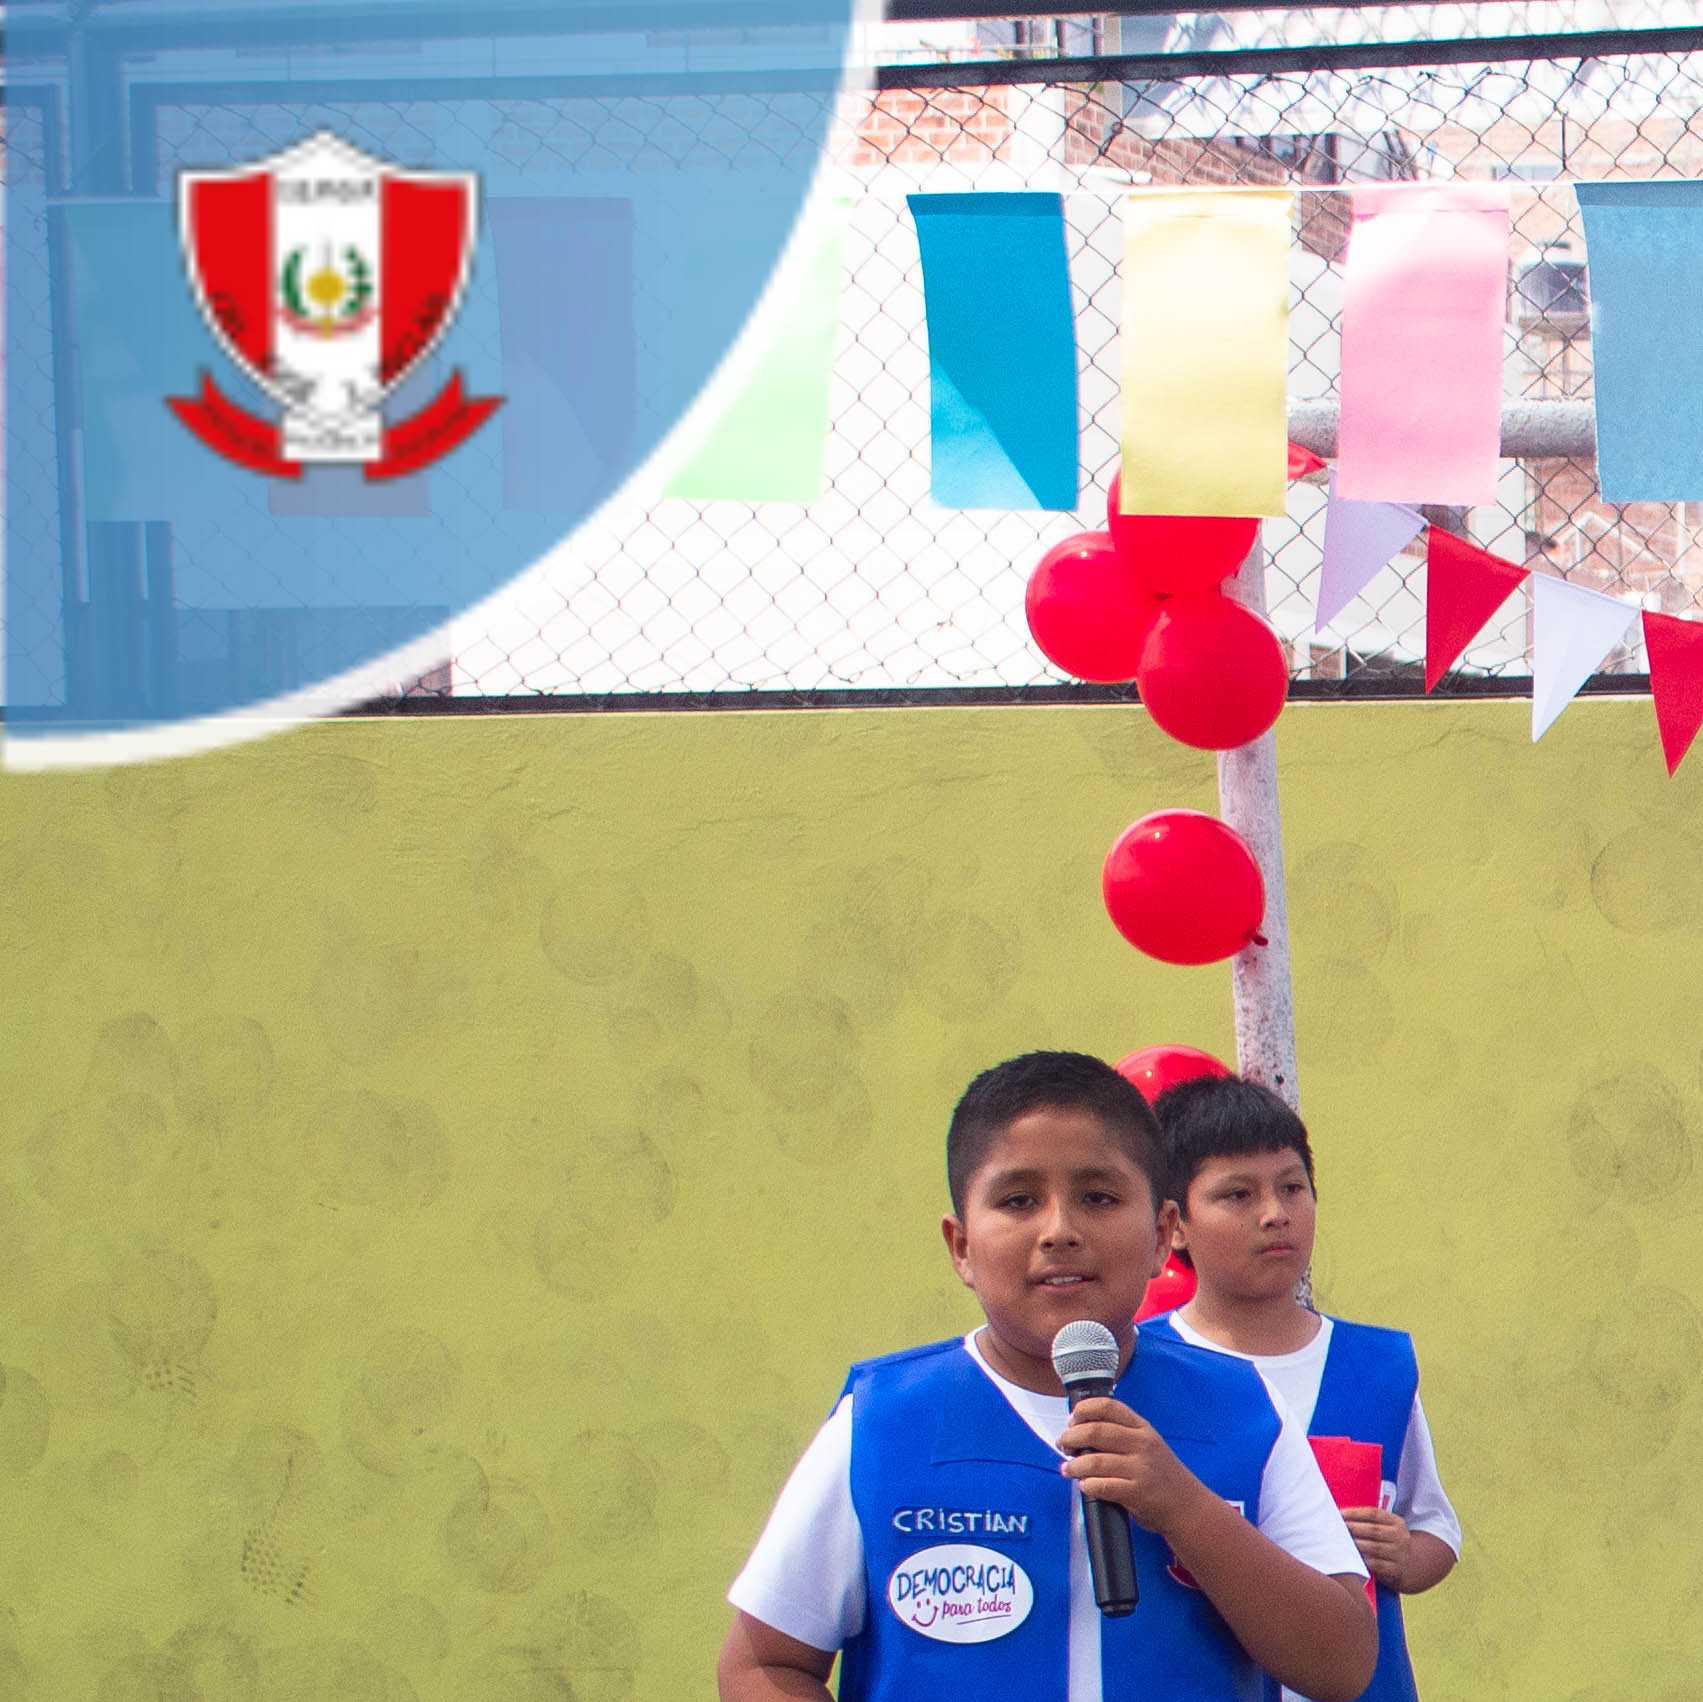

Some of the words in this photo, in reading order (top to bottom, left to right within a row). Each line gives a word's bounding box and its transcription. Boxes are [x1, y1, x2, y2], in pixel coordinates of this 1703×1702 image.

[893, 1506, 1029, 1534] CRISTIAN
[896, 1562, 1017, 1602] DEMOCRACIA
[941, 1598, 974, 1620] para
[977, 1594, 1013, 1614] todos
